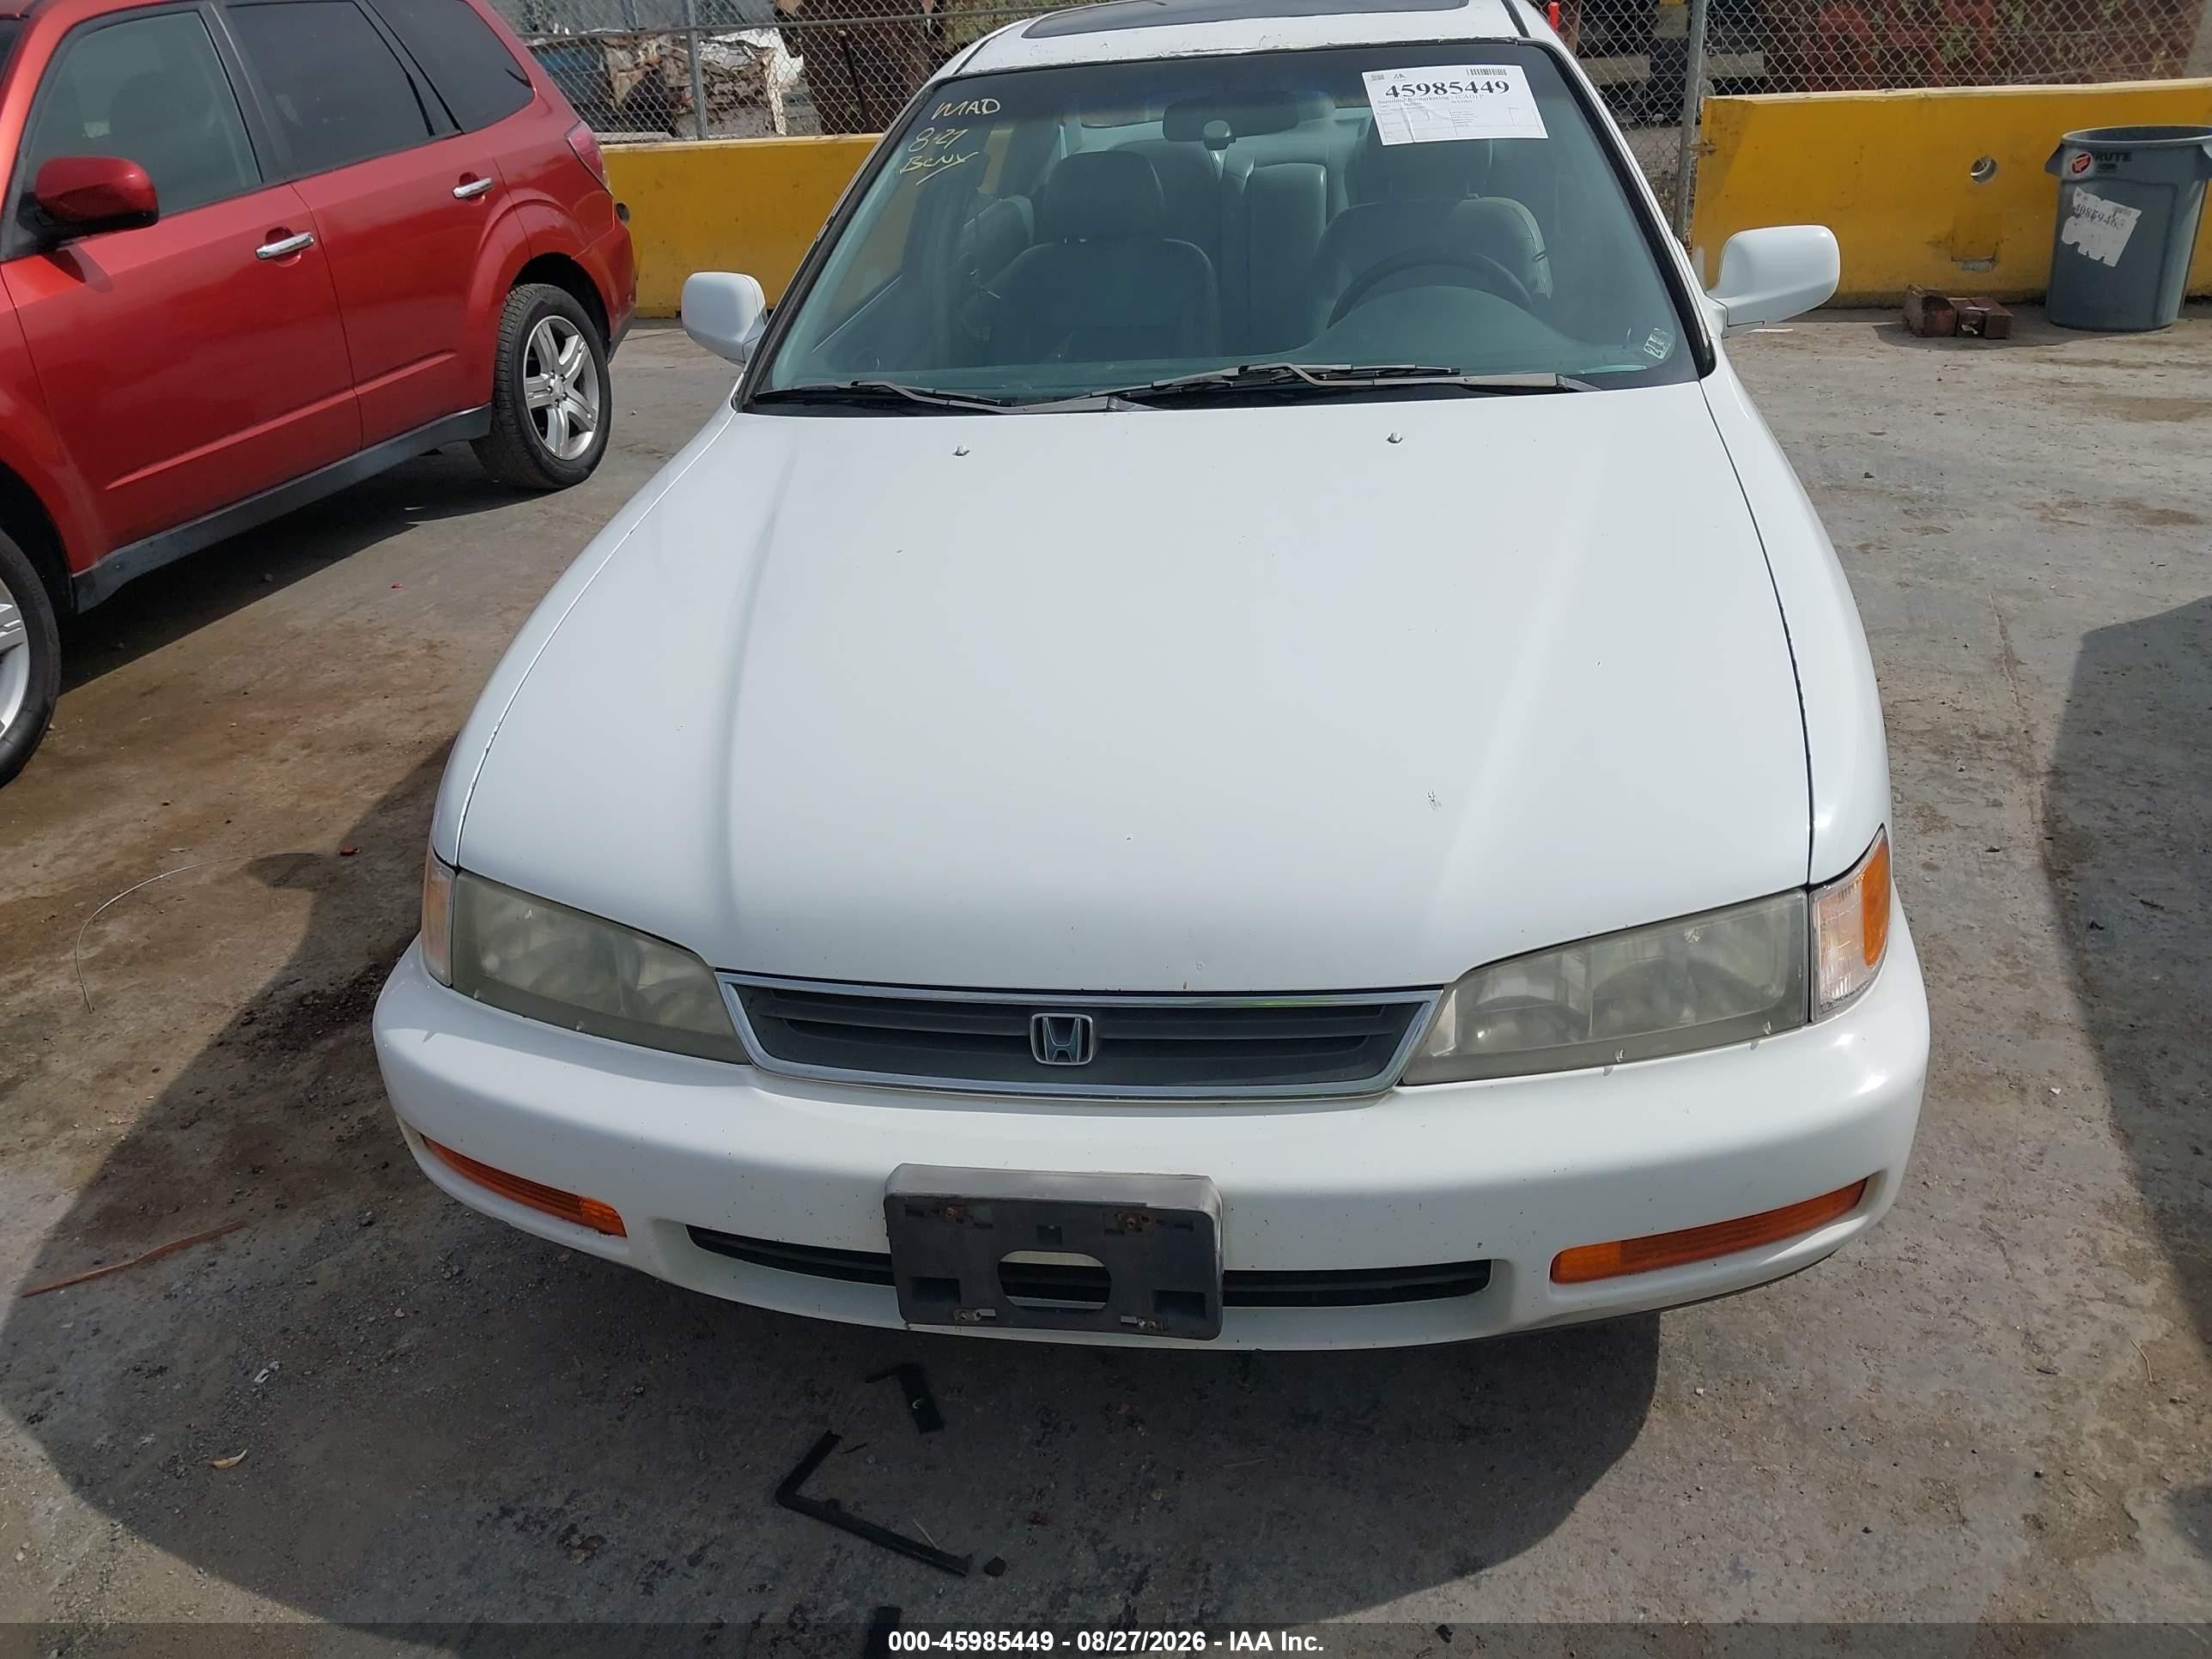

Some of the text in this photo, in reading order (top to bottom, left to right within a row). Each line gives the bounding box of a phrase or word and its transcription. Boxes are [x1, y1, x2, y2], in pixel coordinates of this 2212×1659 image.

[1385, 80, 1510, 98] 45985449
[931, 98, 1001, 120] MAD
[908, 127, 969, 152] 8-27
